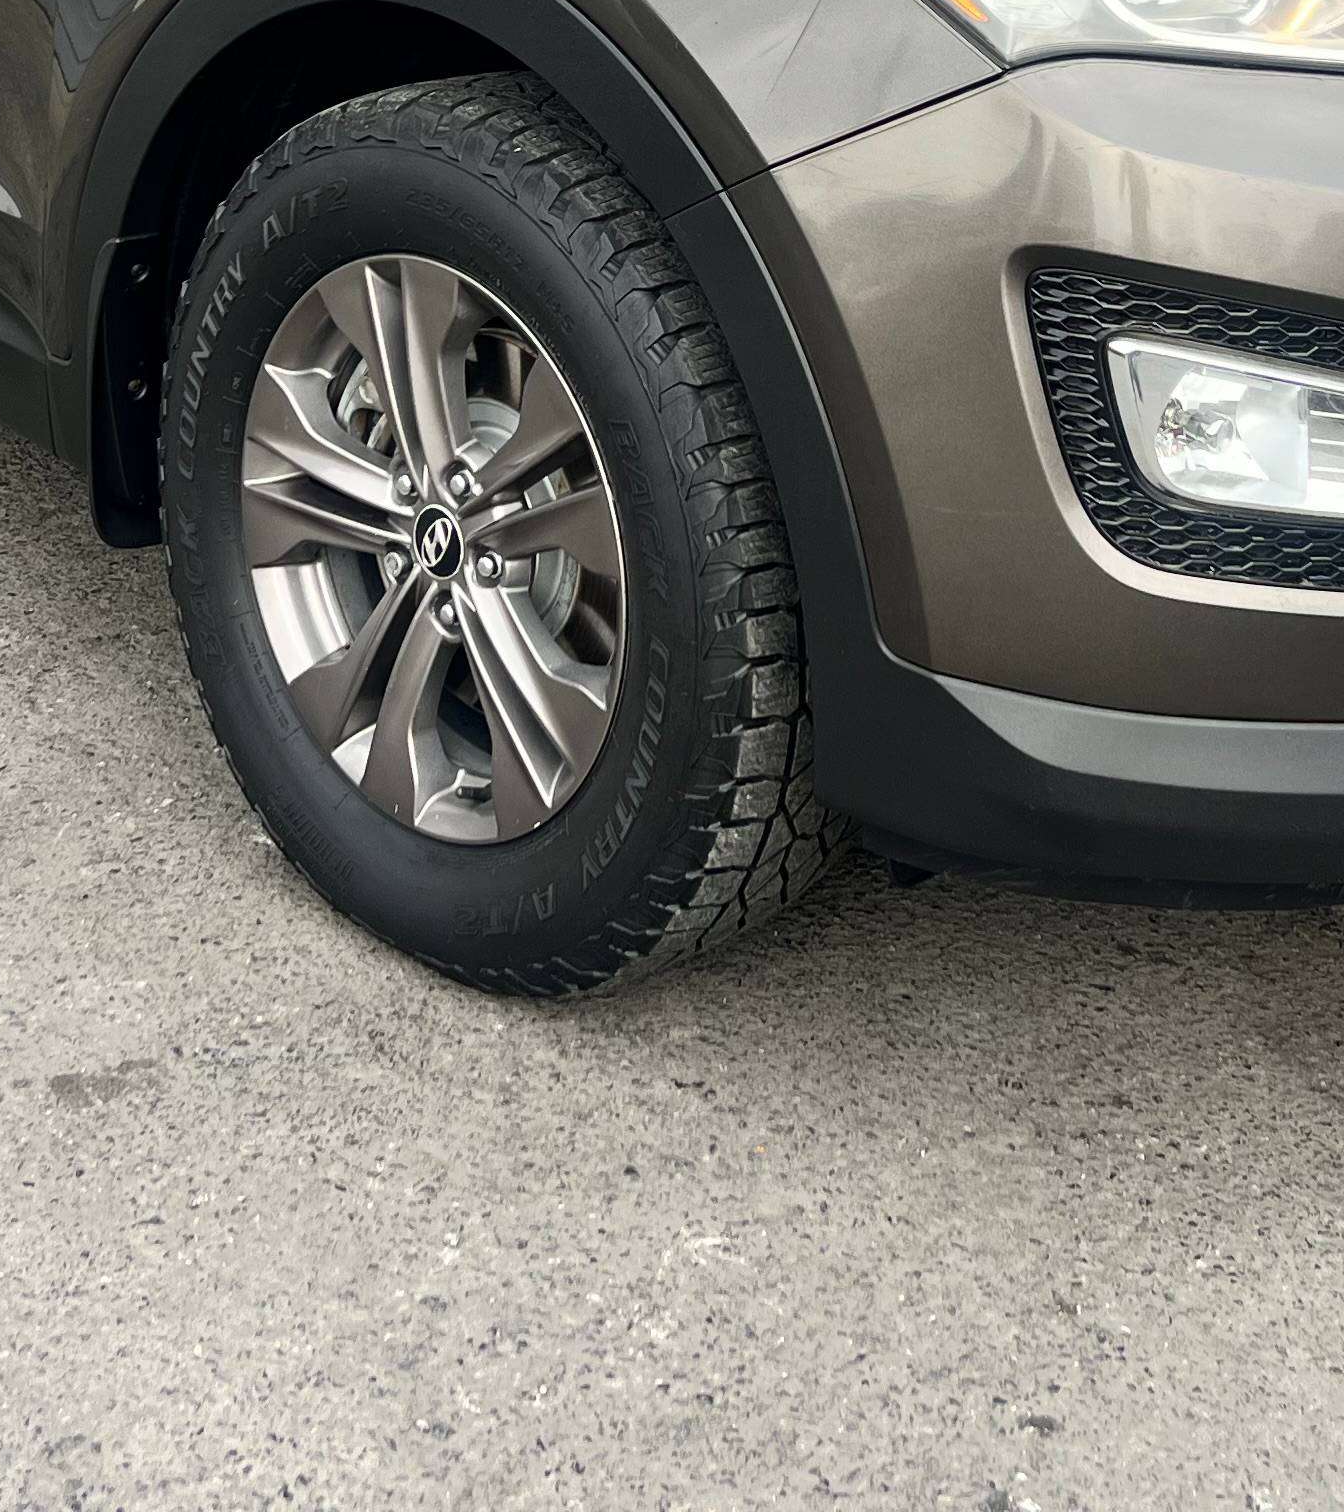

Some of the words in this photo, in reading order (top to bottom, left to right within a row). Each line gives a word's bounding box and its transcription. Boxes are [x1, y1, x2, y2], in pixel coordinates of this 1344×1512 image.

[177, 250, 247, 480] COUNTRY
[262, 176, 349, 250] A/T2
[608, 419, 670, 602] BACK
[581, 637, 671, 890] COUNTRY
